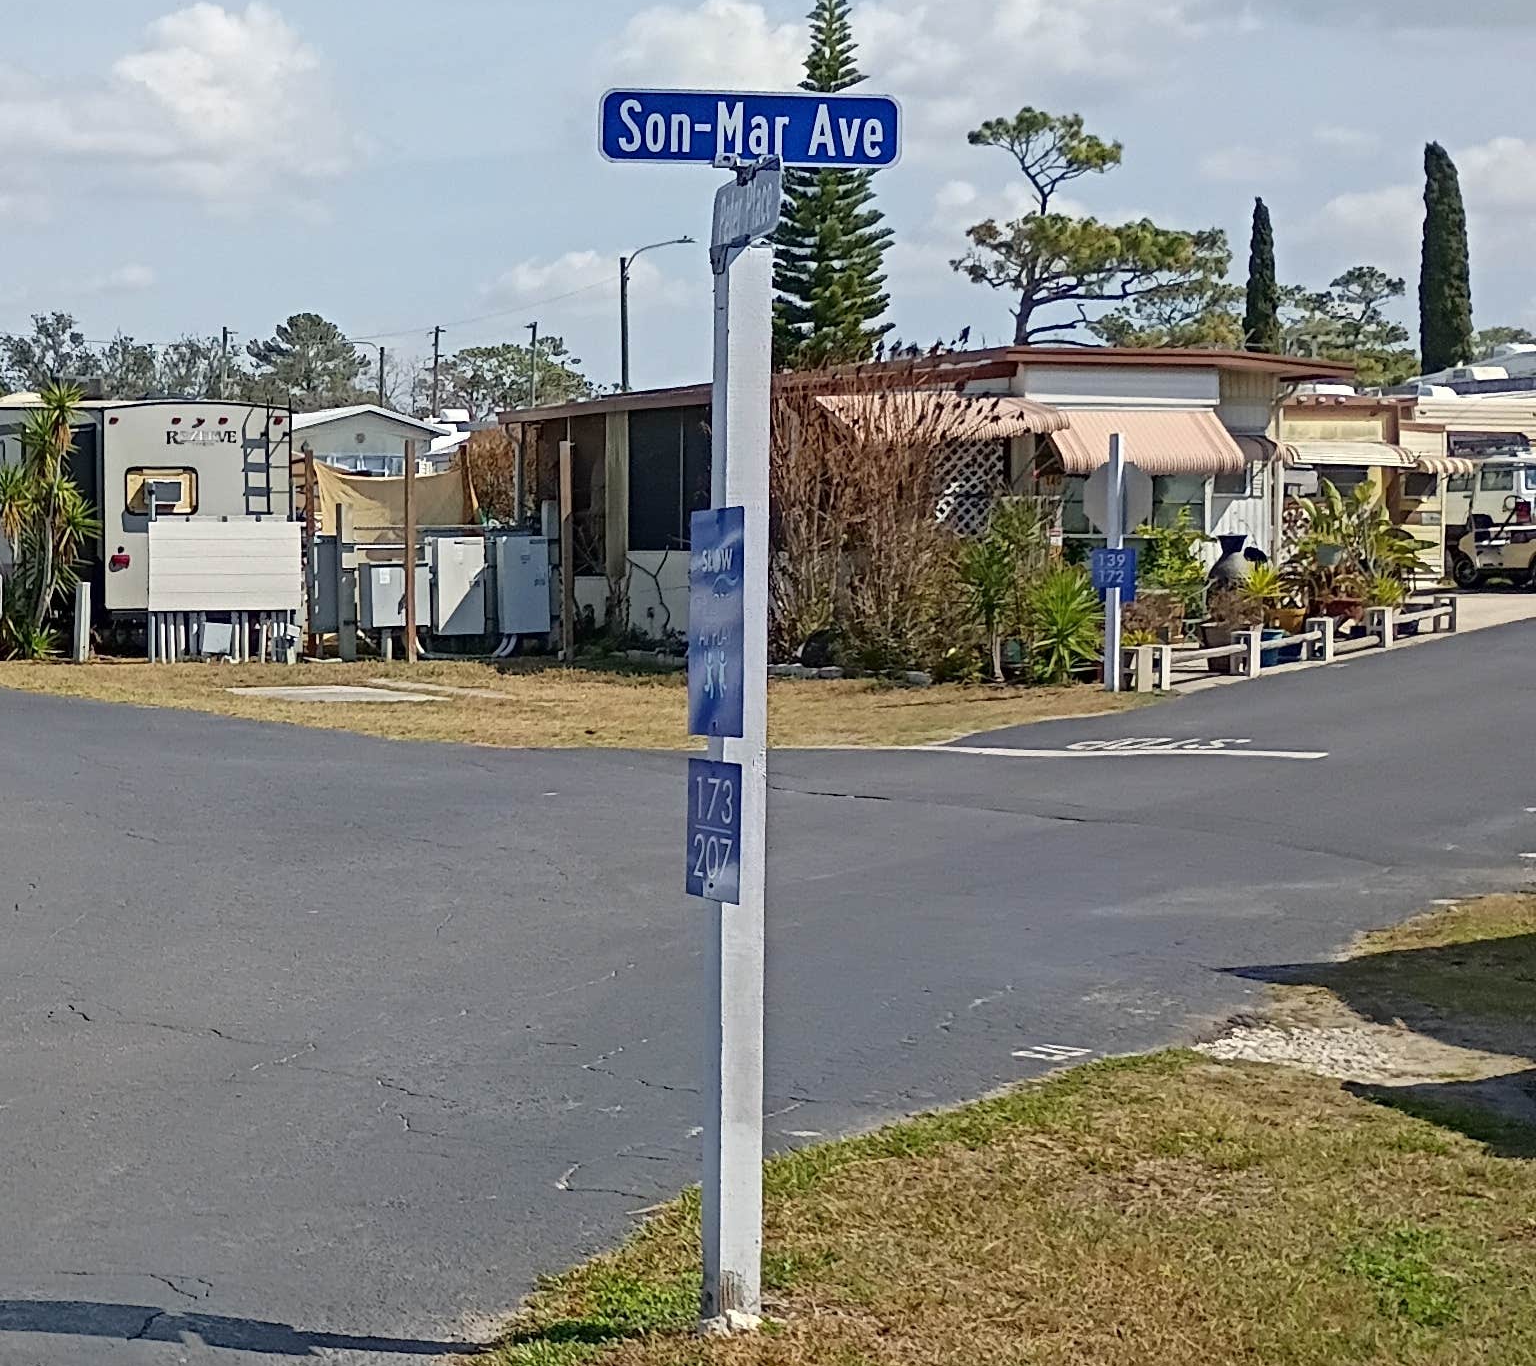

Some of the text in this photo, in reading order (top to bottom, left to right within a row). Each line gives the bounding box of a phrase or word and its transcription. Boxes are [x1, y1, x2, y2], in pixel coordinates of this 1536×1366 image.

[618, 98, 884, 158] Son-Mar Ave
[701, 547, 733, 573] SLOW
[1098, 553, 1126, 568] 139
[1098, 570, 1125, 584] 172
[696, 776, 733, 825] 173
[693, 833, 733, 881] 207
